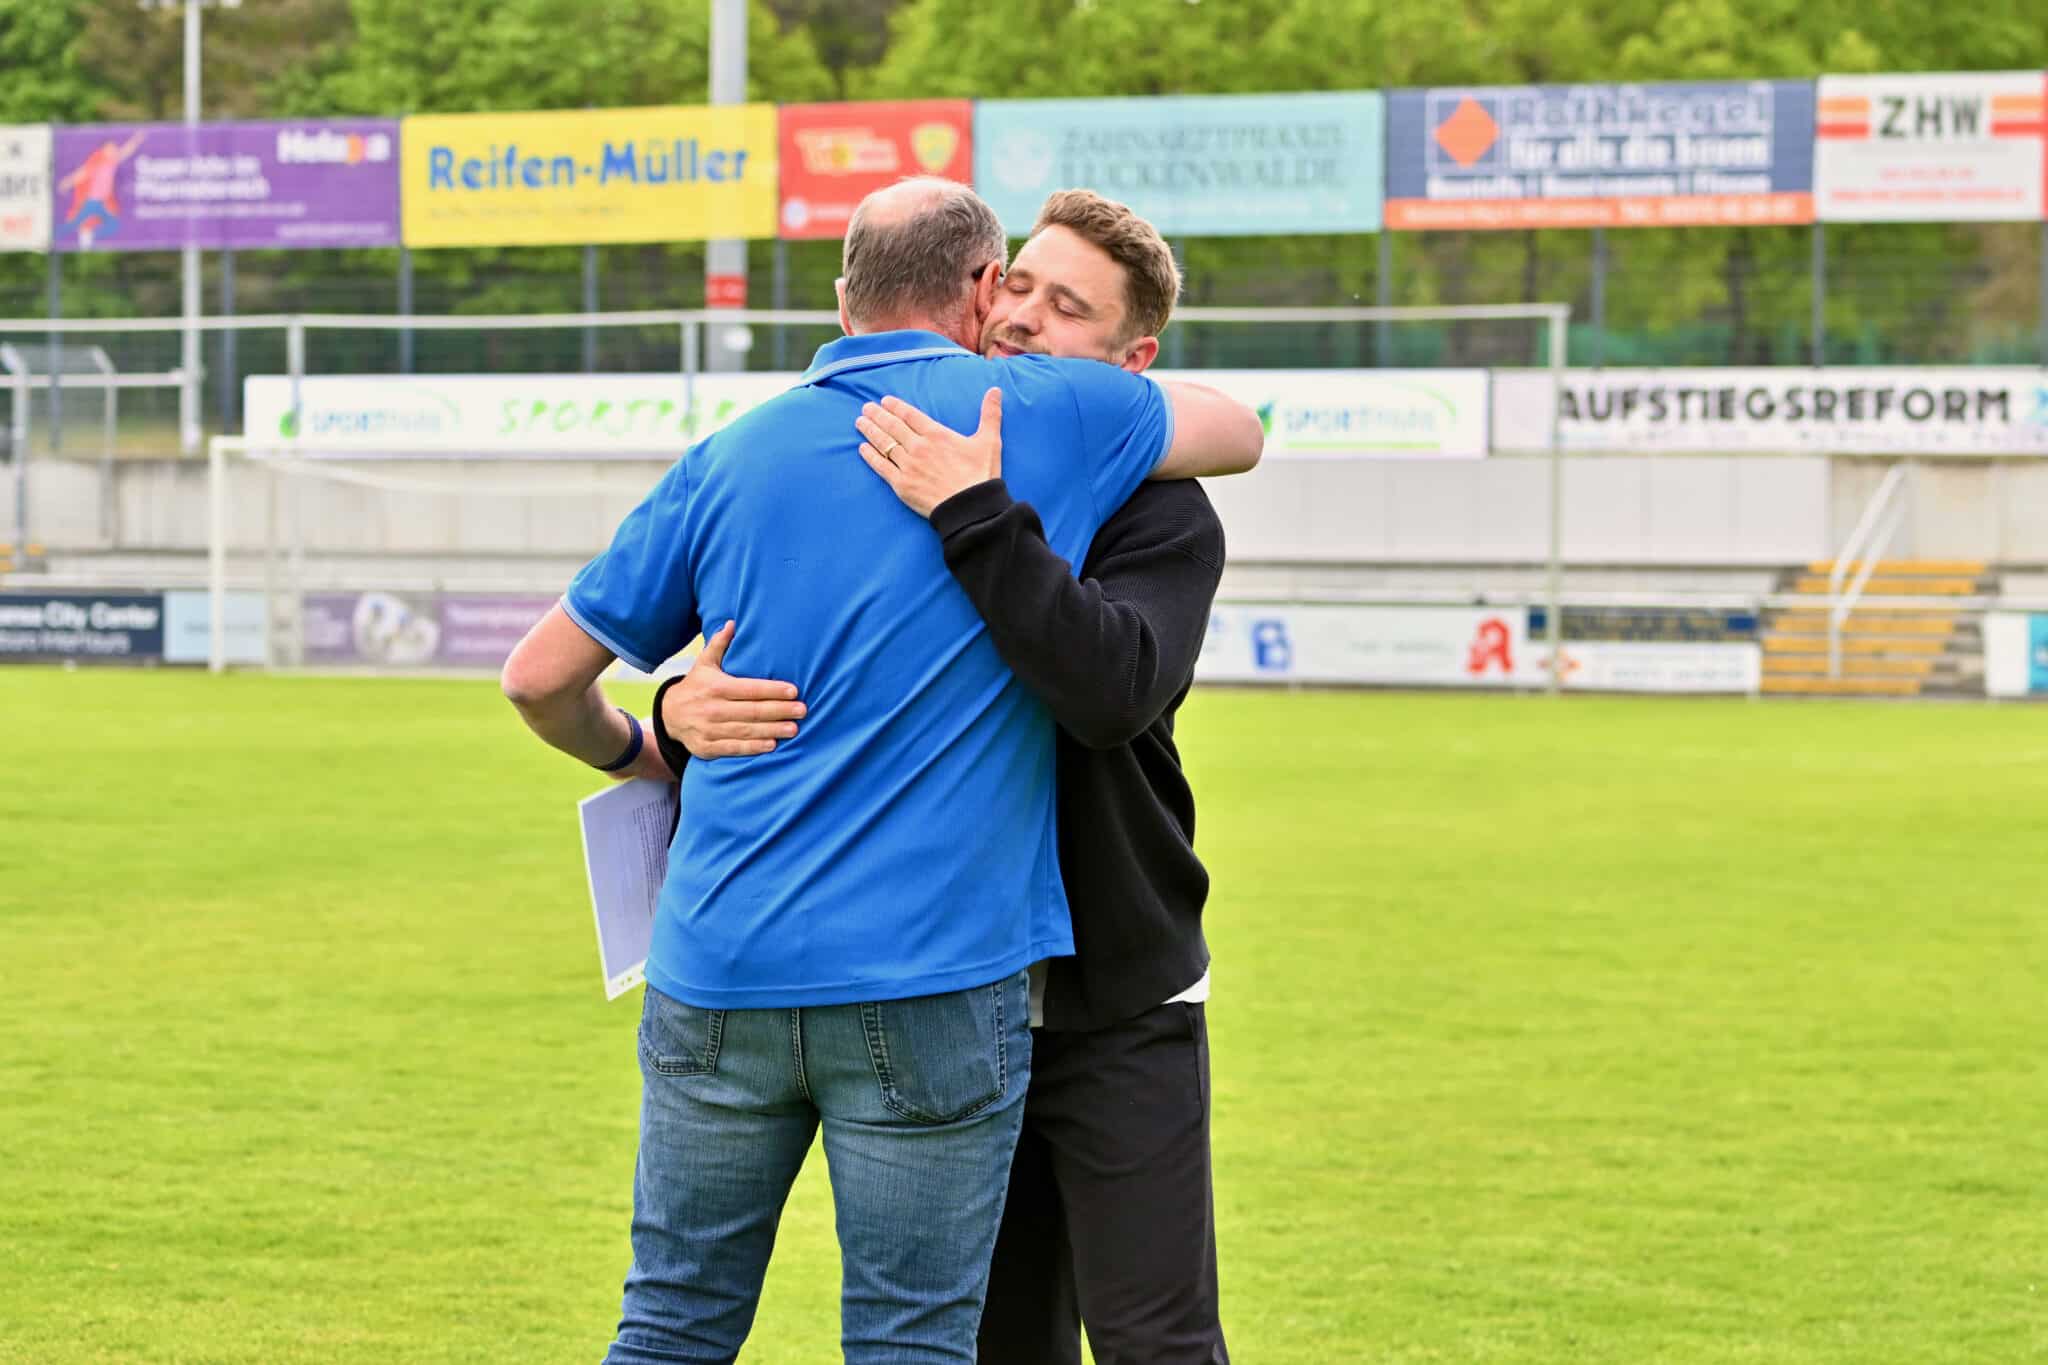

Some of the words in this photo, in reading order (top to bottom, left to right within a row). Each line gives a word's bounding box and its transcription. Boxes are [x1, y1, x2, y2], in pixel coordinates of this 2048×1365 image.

[1880, 95, 1981, 137] ZHW
[428, 139, 748, 189] Reifen-Müller
[1061, 157, 1342, 189] LUCKENWALDE
[497, 398, 739, 436] SPORTPAR
[1559, 386, 2011, 422] AUFSTIEGSREFORM
